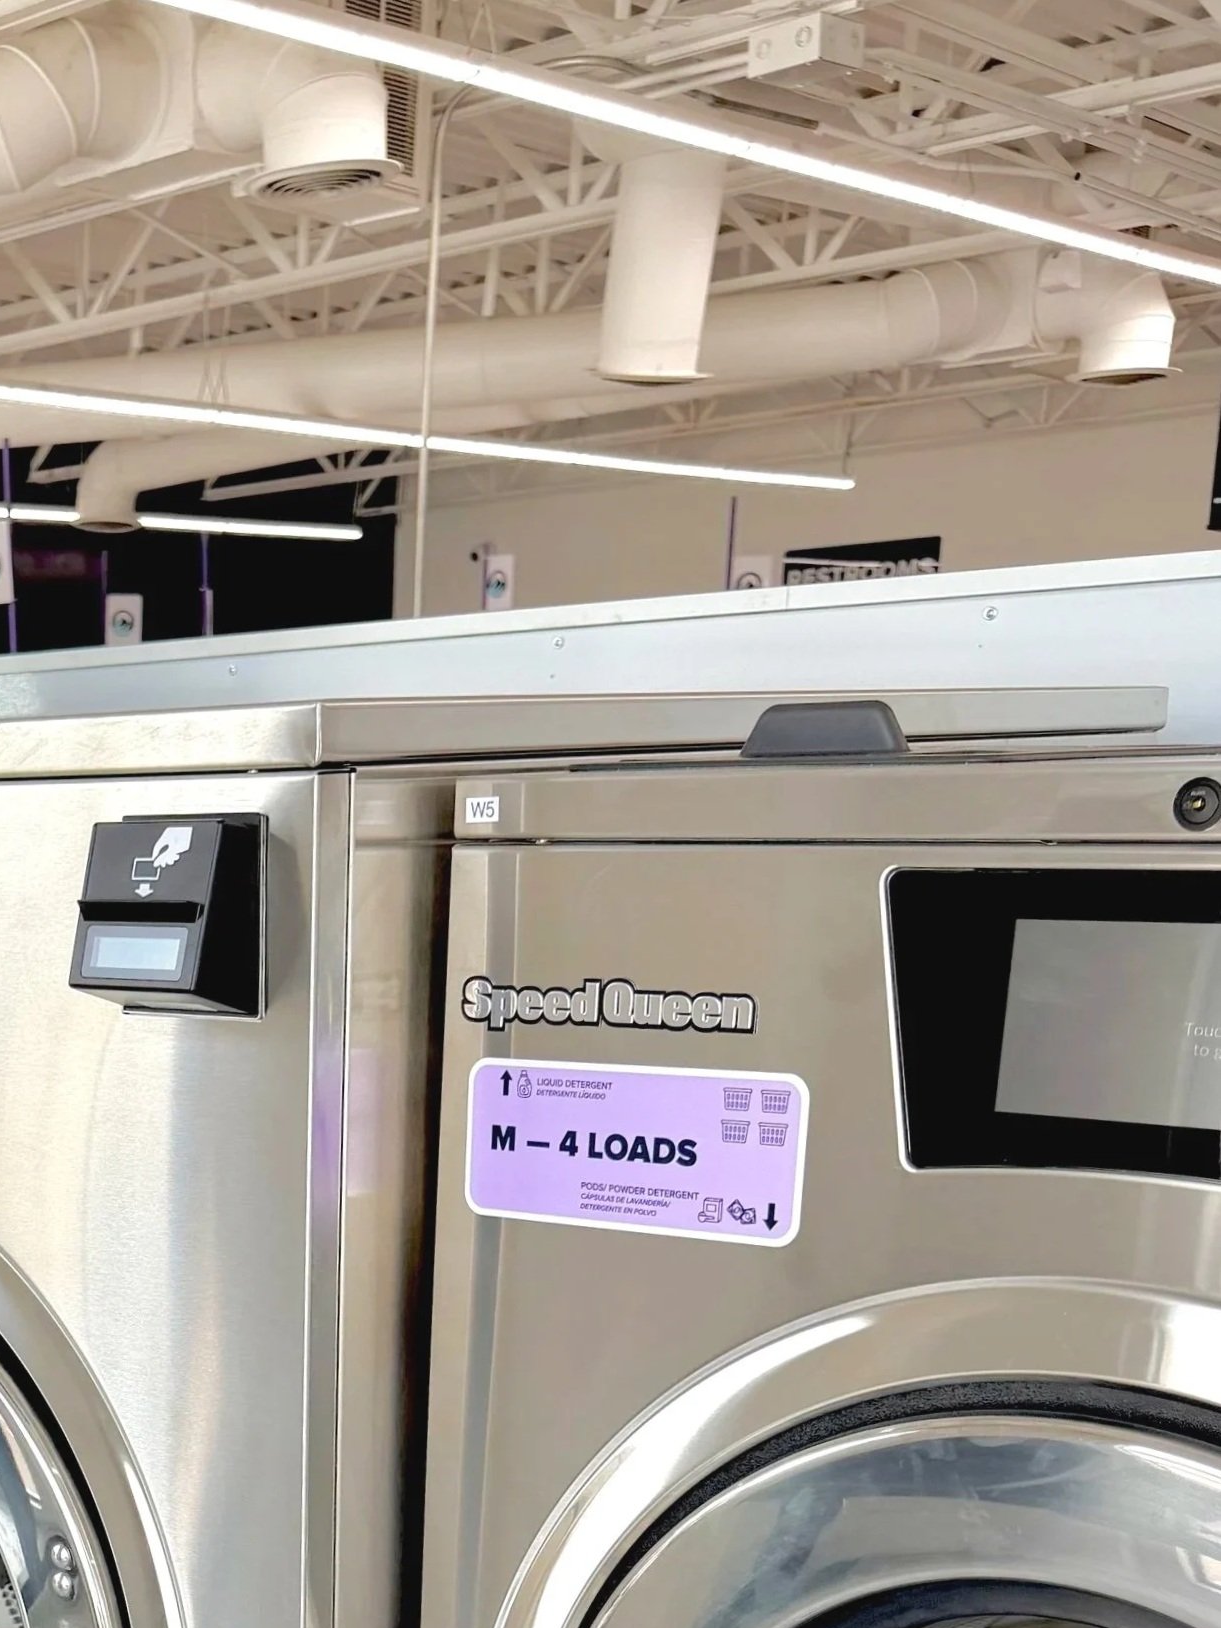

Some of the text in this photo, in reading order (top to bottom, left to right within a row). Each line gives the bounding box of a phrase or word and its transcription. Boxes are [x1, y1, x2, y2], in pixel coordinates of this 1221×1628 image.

[470, 801, 495, 818] W5
[462, 976, 757, 1034] Speed Queen
[537, 1078, 612, 1090] LIQUID DETERGENT
[536, 1089, 577, 1098] DETERGENTE
[491, 1124, 516, 1151] M
[559, 1130, 578, 1156] 4
[588, 1132, 697, 1166] LOADS
[581, 1182, 699, 1200] PODS/ POWDER DETERGENT
[580, 1203, 622, 1213] DETERGENTE
[634, 1208, 657, 1216] POLVO
